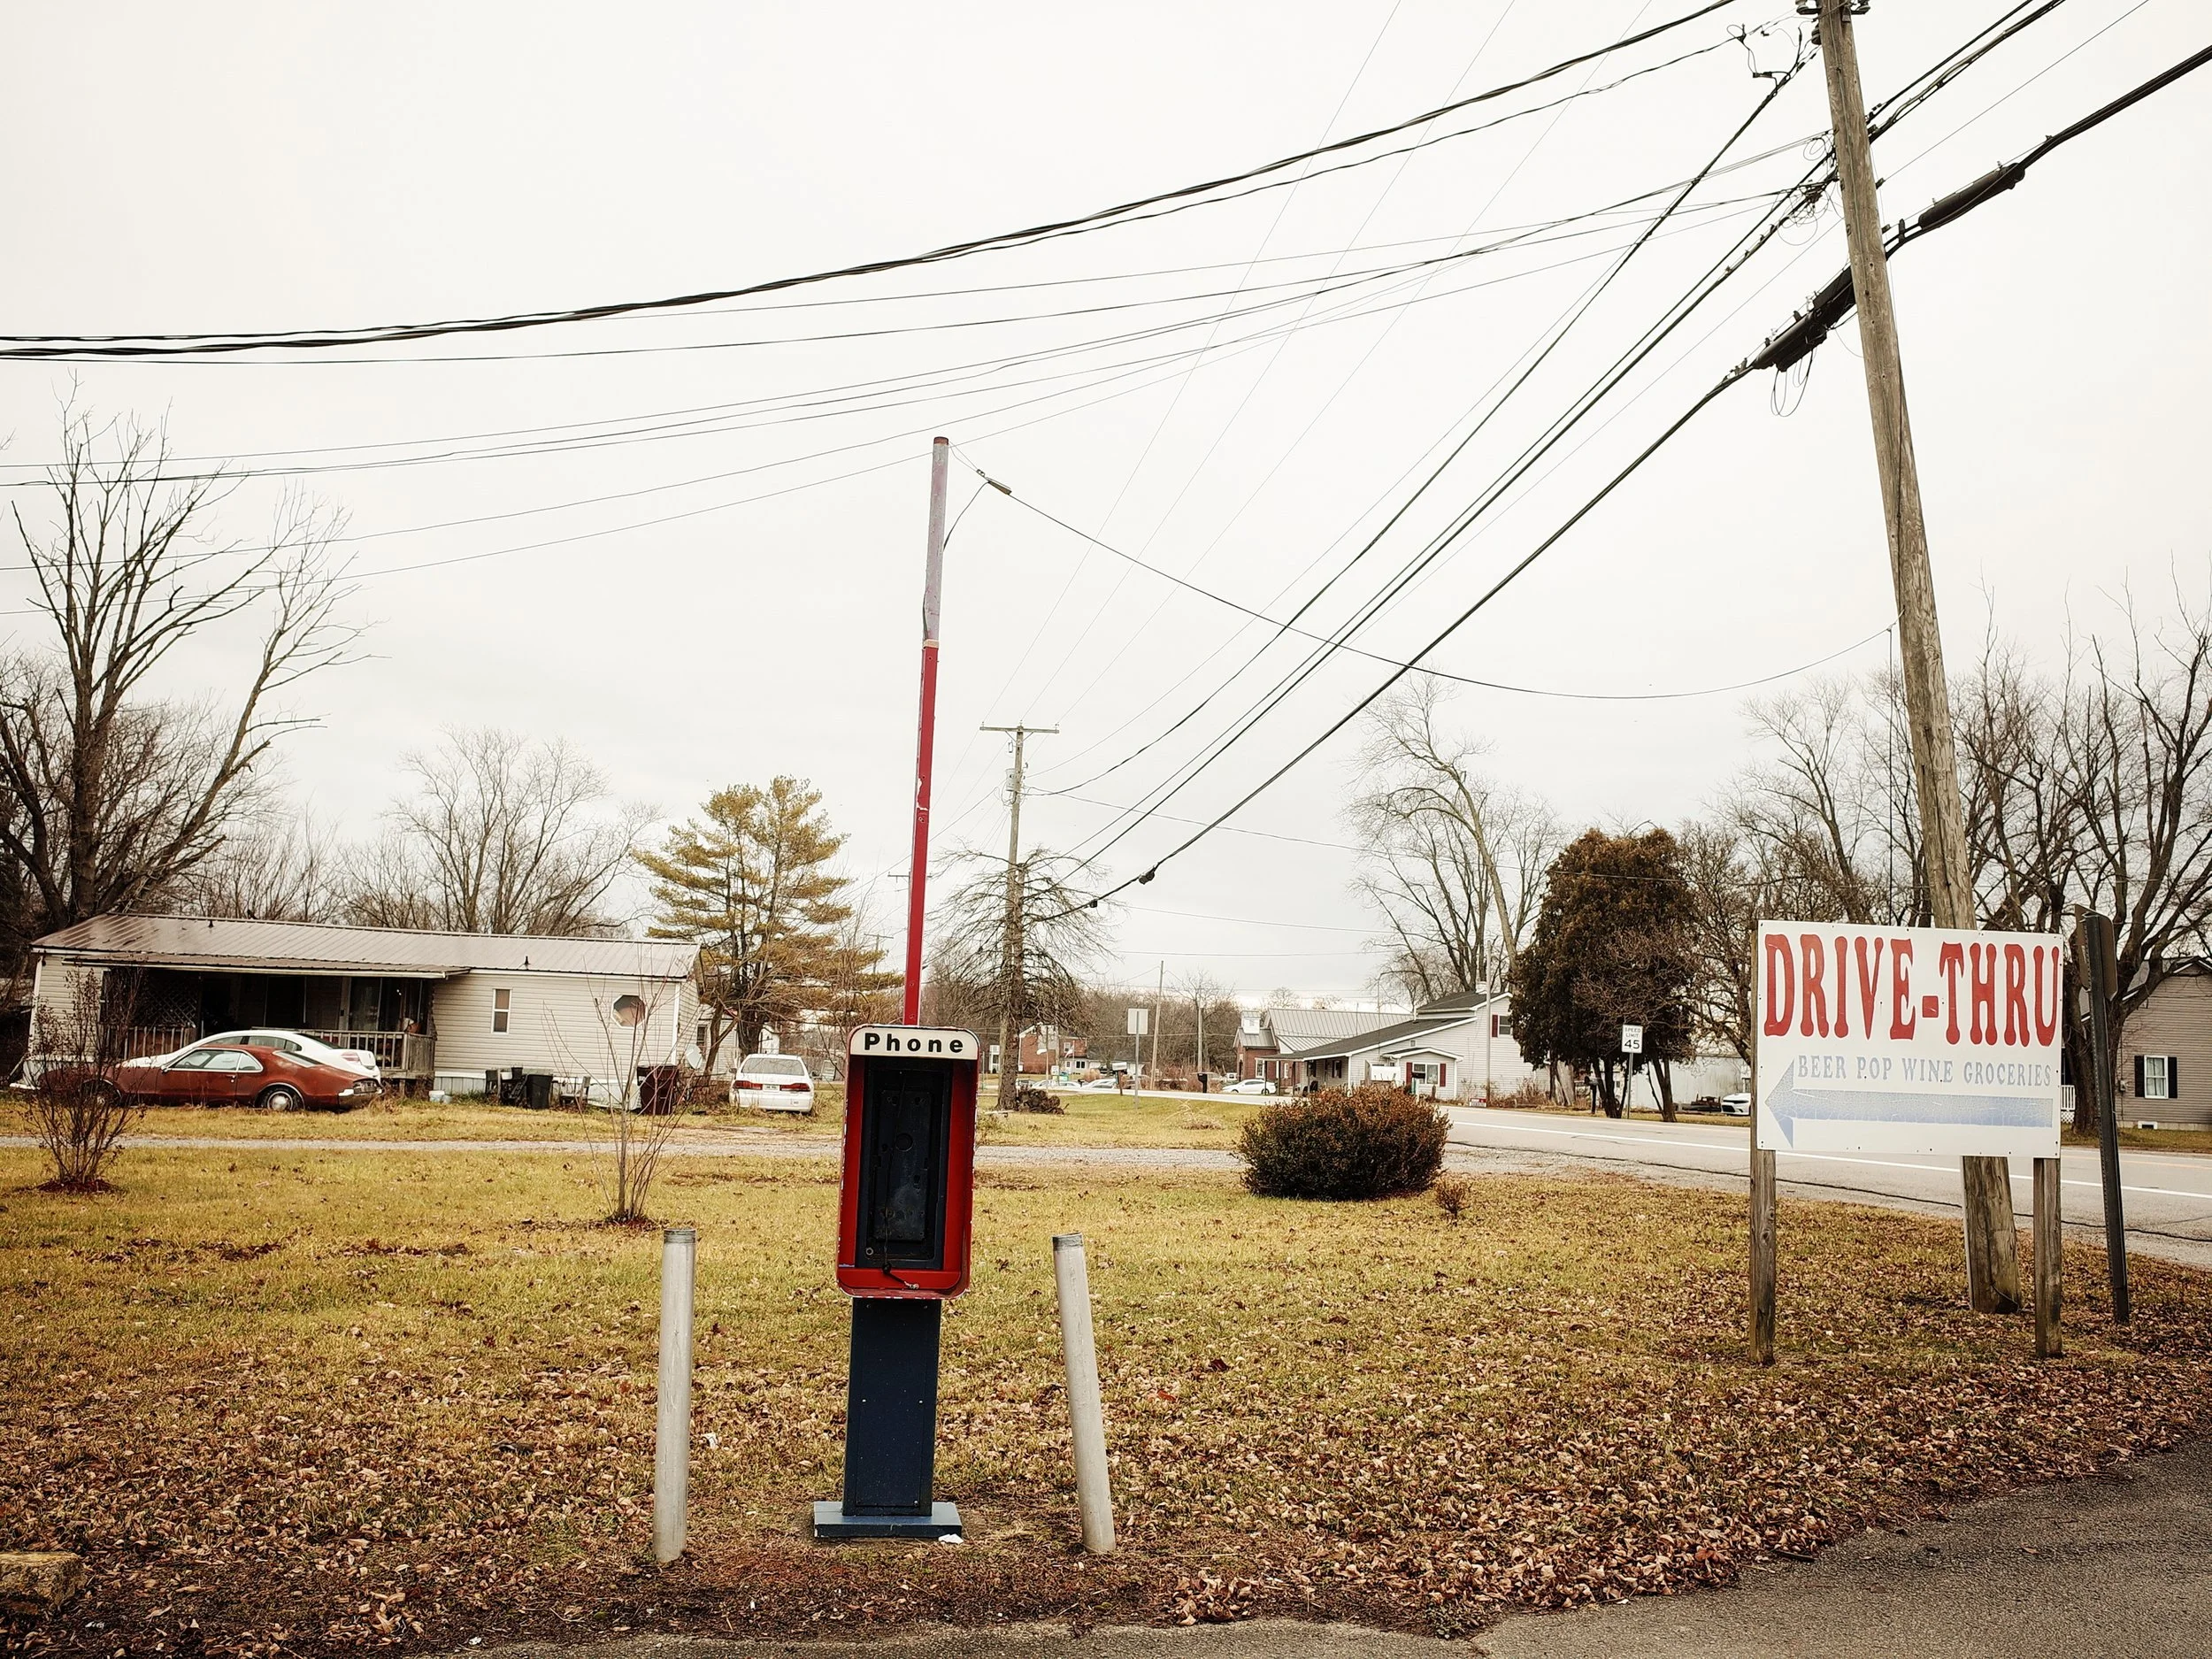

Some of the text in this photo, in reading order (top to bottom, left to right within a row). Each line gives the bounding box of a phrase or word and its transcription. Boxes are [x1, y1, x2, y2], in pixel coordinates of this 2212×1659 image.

[1763, 933, 2060, 1048] DRIVE-THRU
[864, 1032, 964, 1053] Phone
[1624, 1040, 1640, 1049] 45
[1797, 1055, 2052, 1087] BEER POP WINE GROCERIES
